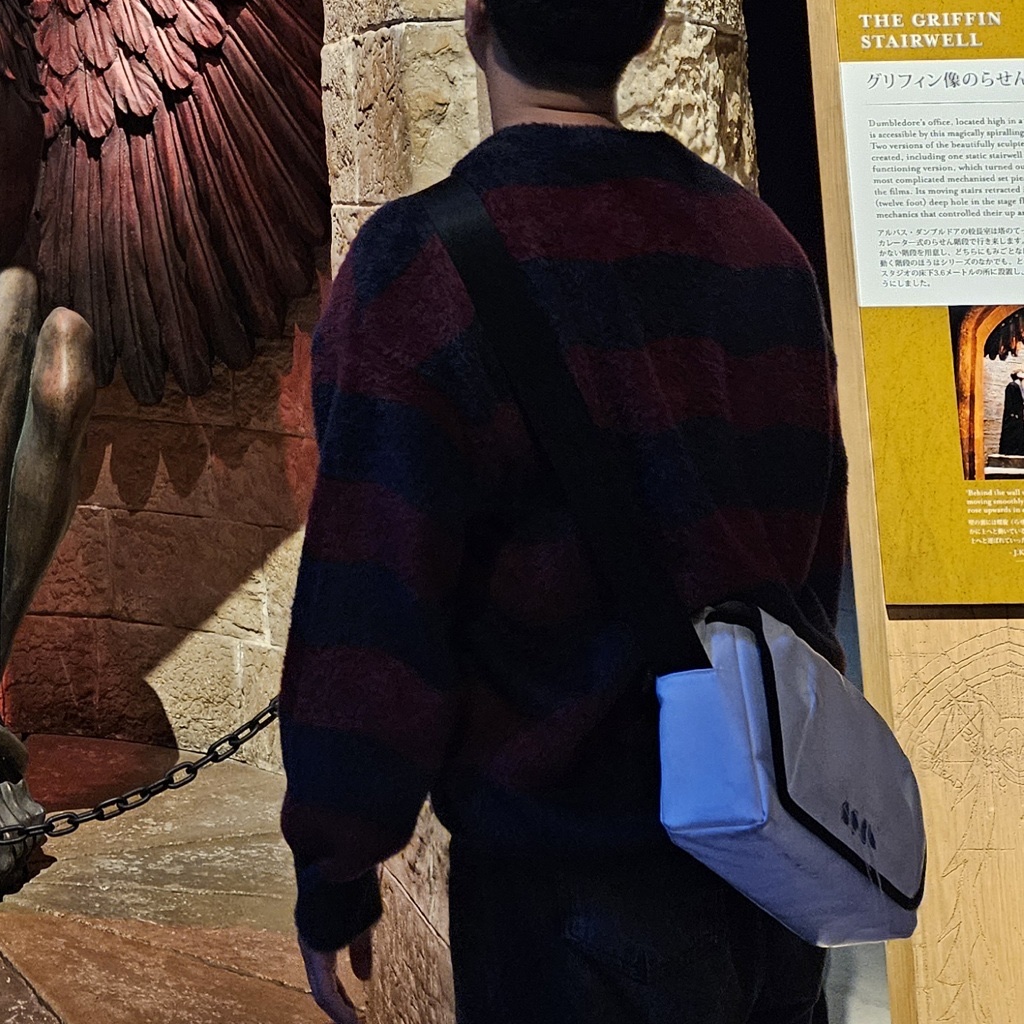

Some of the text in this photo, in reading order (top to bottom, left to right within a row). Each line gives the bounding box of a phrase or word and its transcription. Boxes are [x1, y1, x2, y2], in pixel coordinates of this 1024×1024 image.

[859, 12, 1001, 28] THE GRIFFIN
[861, 33, 983, 49] STAIRWELL
[869, 119, 926, 127] Dumbledore's
[928, 118, 953, 126] office,
[956, 117, 985, 125] located
[988, 117, 1005, 127] high
[879, 130, 917, 138] accessible
[919, 130, 928, 140] by
[947, 129, 984, 139] magically
[951, 140, 995, 150] beautifully
[872, 153, 904, 162] created,
[906, 153, 946, 162] including
[989, 151, 1022, 159] stairwell
[872, 165, 921, 174] functioning
[896, 175, 945, 185] complicated
[947, 174, 995, 182] mechanised
[928, 187, 959, 196] moving
[876, 199, 903, 207] (twelve
[906, 198, 926, 206] foot)
[929, 199, 949, 208] deep
[982, 197, 995, 205] the
[997, 199, 1016, 207] stage
[939, 209, 981, 217] controlled
